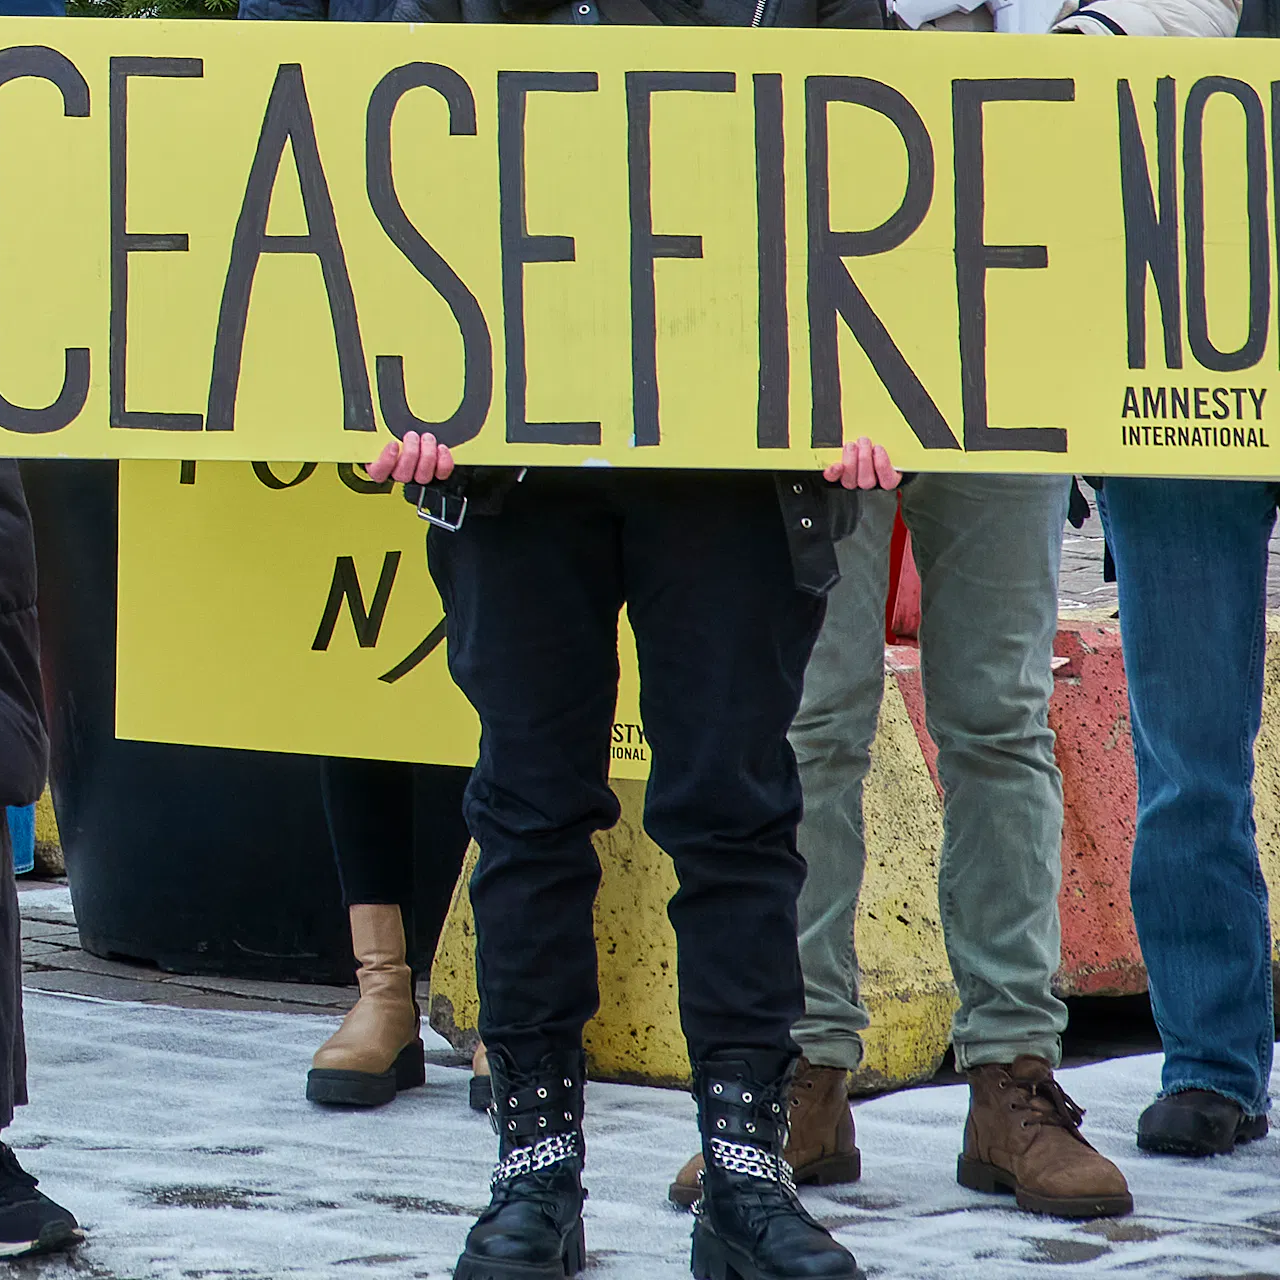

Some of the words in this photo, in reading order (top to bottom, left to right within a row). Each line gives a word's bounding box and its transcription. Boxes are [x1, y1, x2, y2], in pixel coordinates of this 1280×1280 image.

[1116, 74, 1280, 373] NO
[1121, 386, 1268, 421] AMNESTY
[1122, 425, 1270, 448] INTERNATIONAL
